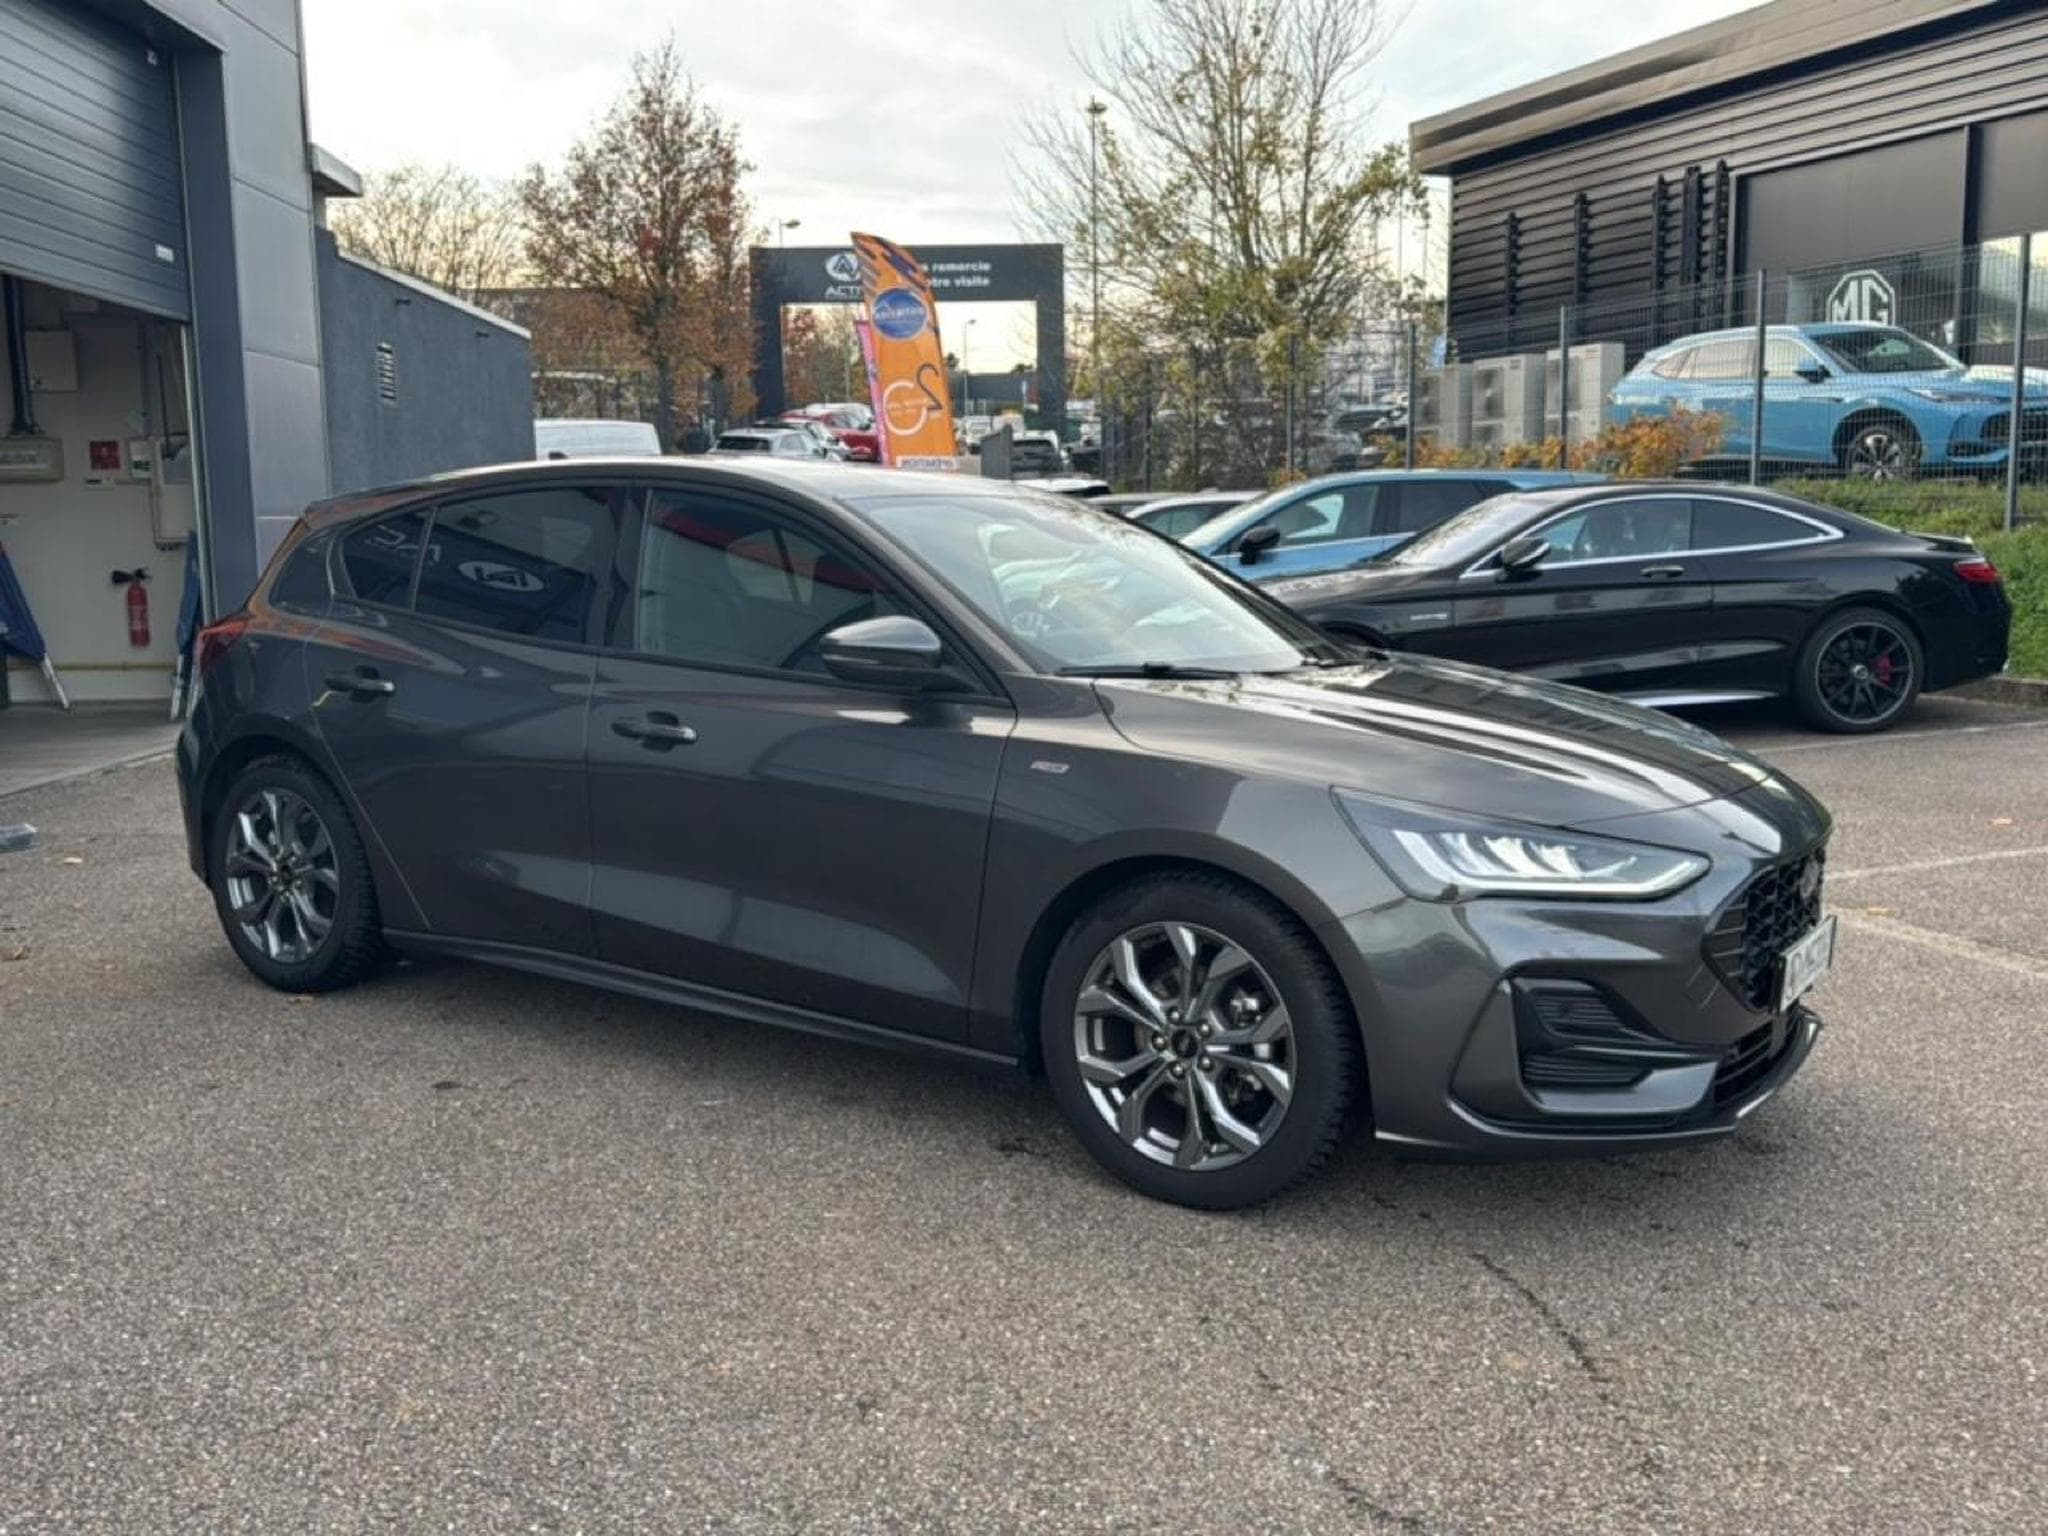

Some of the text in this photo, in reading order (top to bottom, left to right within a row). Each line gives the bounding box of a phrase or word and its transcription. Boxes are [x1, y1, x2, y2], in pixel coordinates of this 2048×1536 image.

[932, 261, 992, 272] remercie
[954, 275, 990, 288] visite
[1831, 278, 1889, 327] MG
